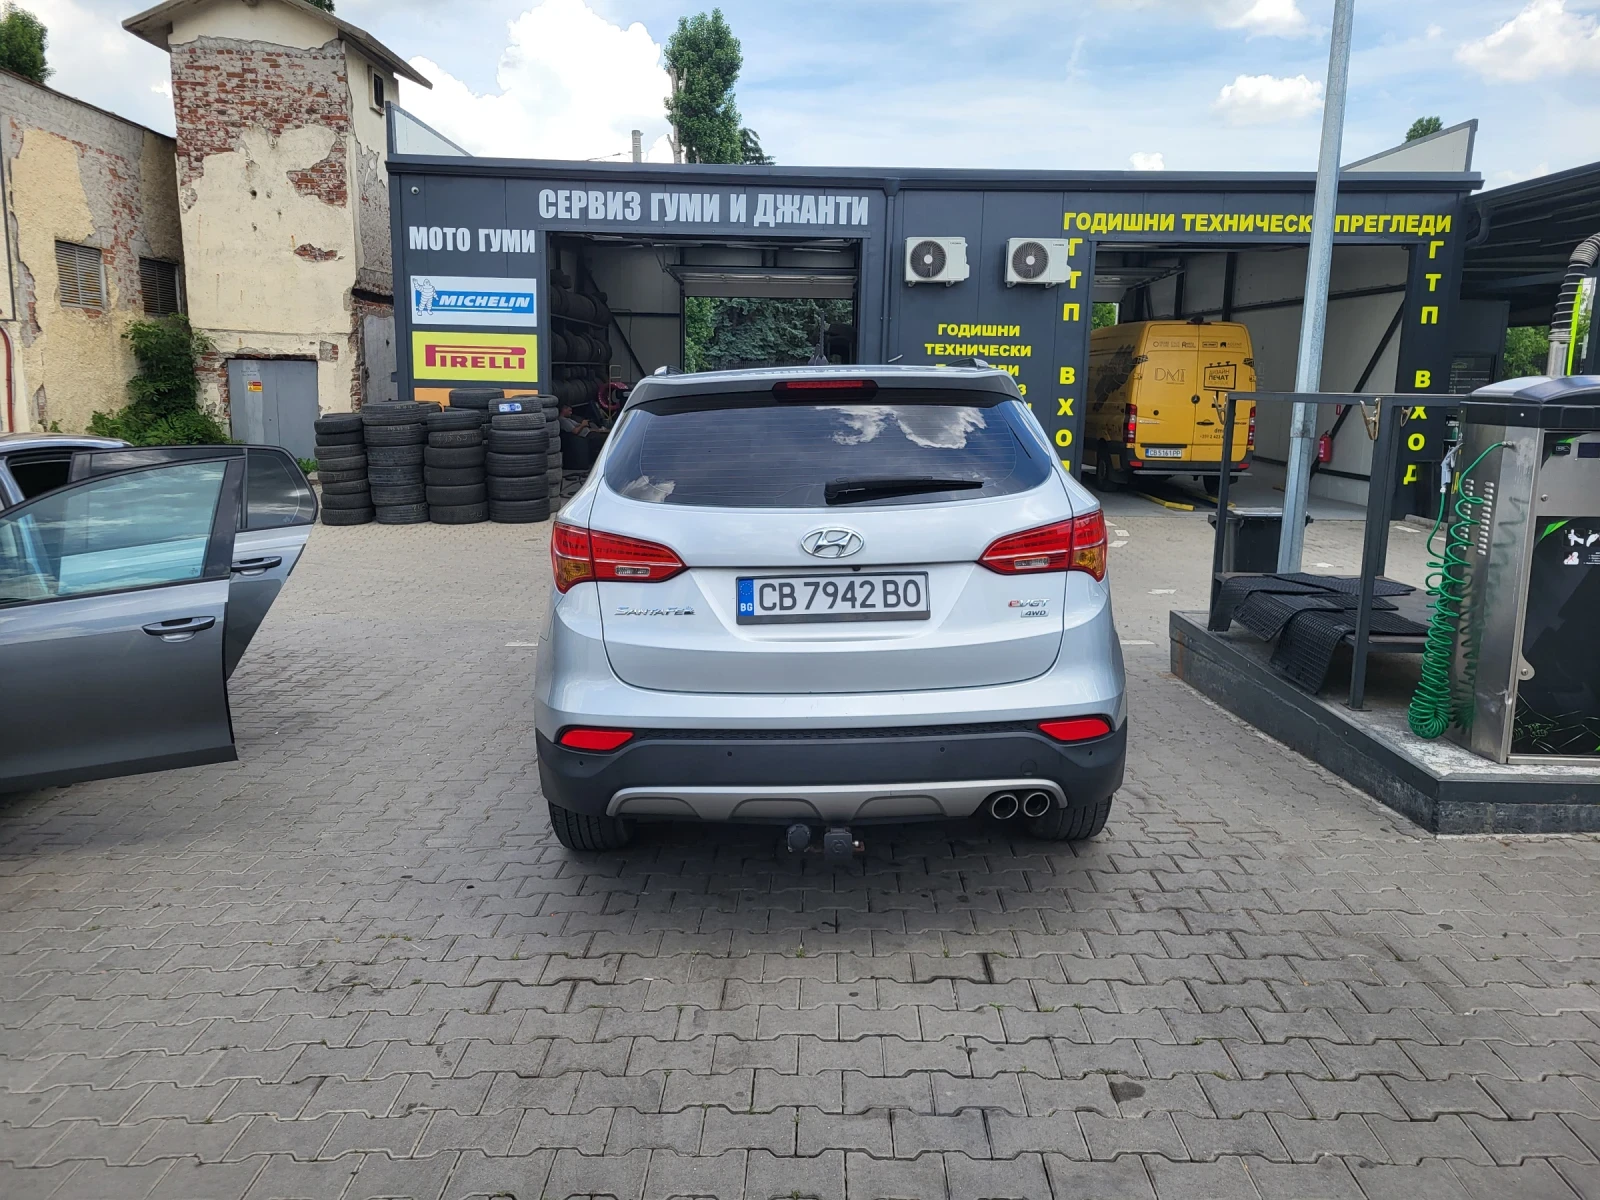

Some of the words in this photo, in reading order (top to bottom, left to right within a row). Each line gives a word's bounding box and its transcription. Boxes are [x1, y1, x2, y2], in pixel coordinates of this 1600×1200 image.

[538, 188, 641, 221] СЕРВИЗ
[650, 192, 720, 222] ГУМИ
[729, 193, 747, 223] И
[753, 193, 869, 228] ДЖАНТИ
[1063, 212, 1175, 234] ГОДИШНИ
[1181, 213, 1313, 233] ТЕХНИЧЕСК
[1333, 214, 1452, 236] ПРЕГЛЕДИ
[408, 226, 471, 252] МОТО
[478, 228, 536, 253] ГУМИ
[438, 294, 531, 308] MICHELIN
[937, 323, 1021, 338] ГОДИШНИ
[424, 344, 527, 370] PIRELLI
[924, 343, 1032, 357] ТЕХНИЧЕСКИ
[740, 602, 753, 612] BG
[803, 580, 876, 610] 7942
